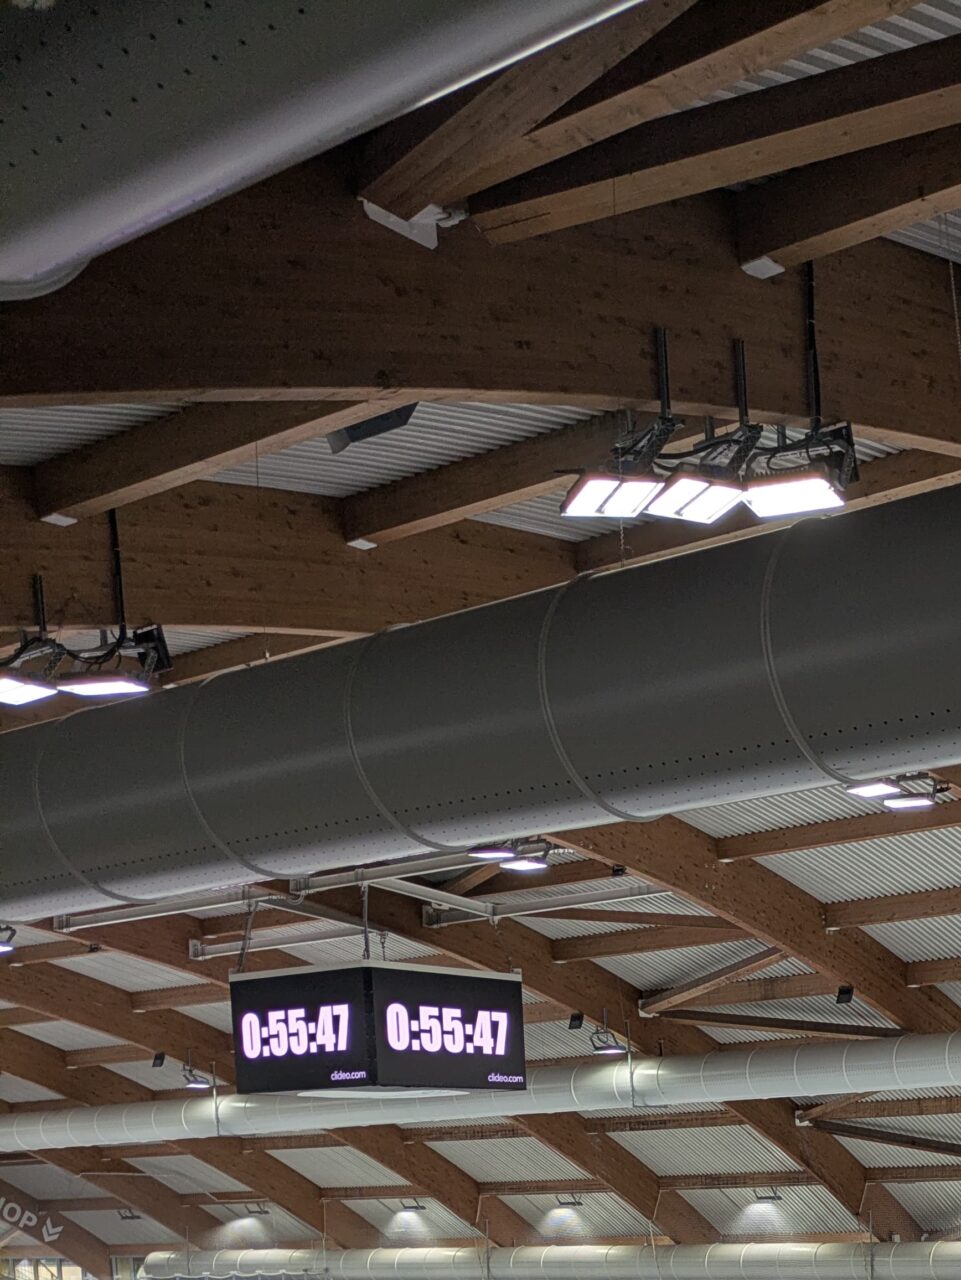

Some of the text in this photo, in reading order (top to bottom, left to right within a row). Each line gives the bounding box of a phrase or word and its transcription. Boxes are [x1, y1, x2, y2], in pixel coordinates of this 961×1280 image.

[242, 1004, 349, 1059] 0:55:47
[386, 1003, 508, 1056] 0:55:47
[331, 1071, 366, 1080] clideo.com
[487, 1073, 524, 1083] clideo.com
